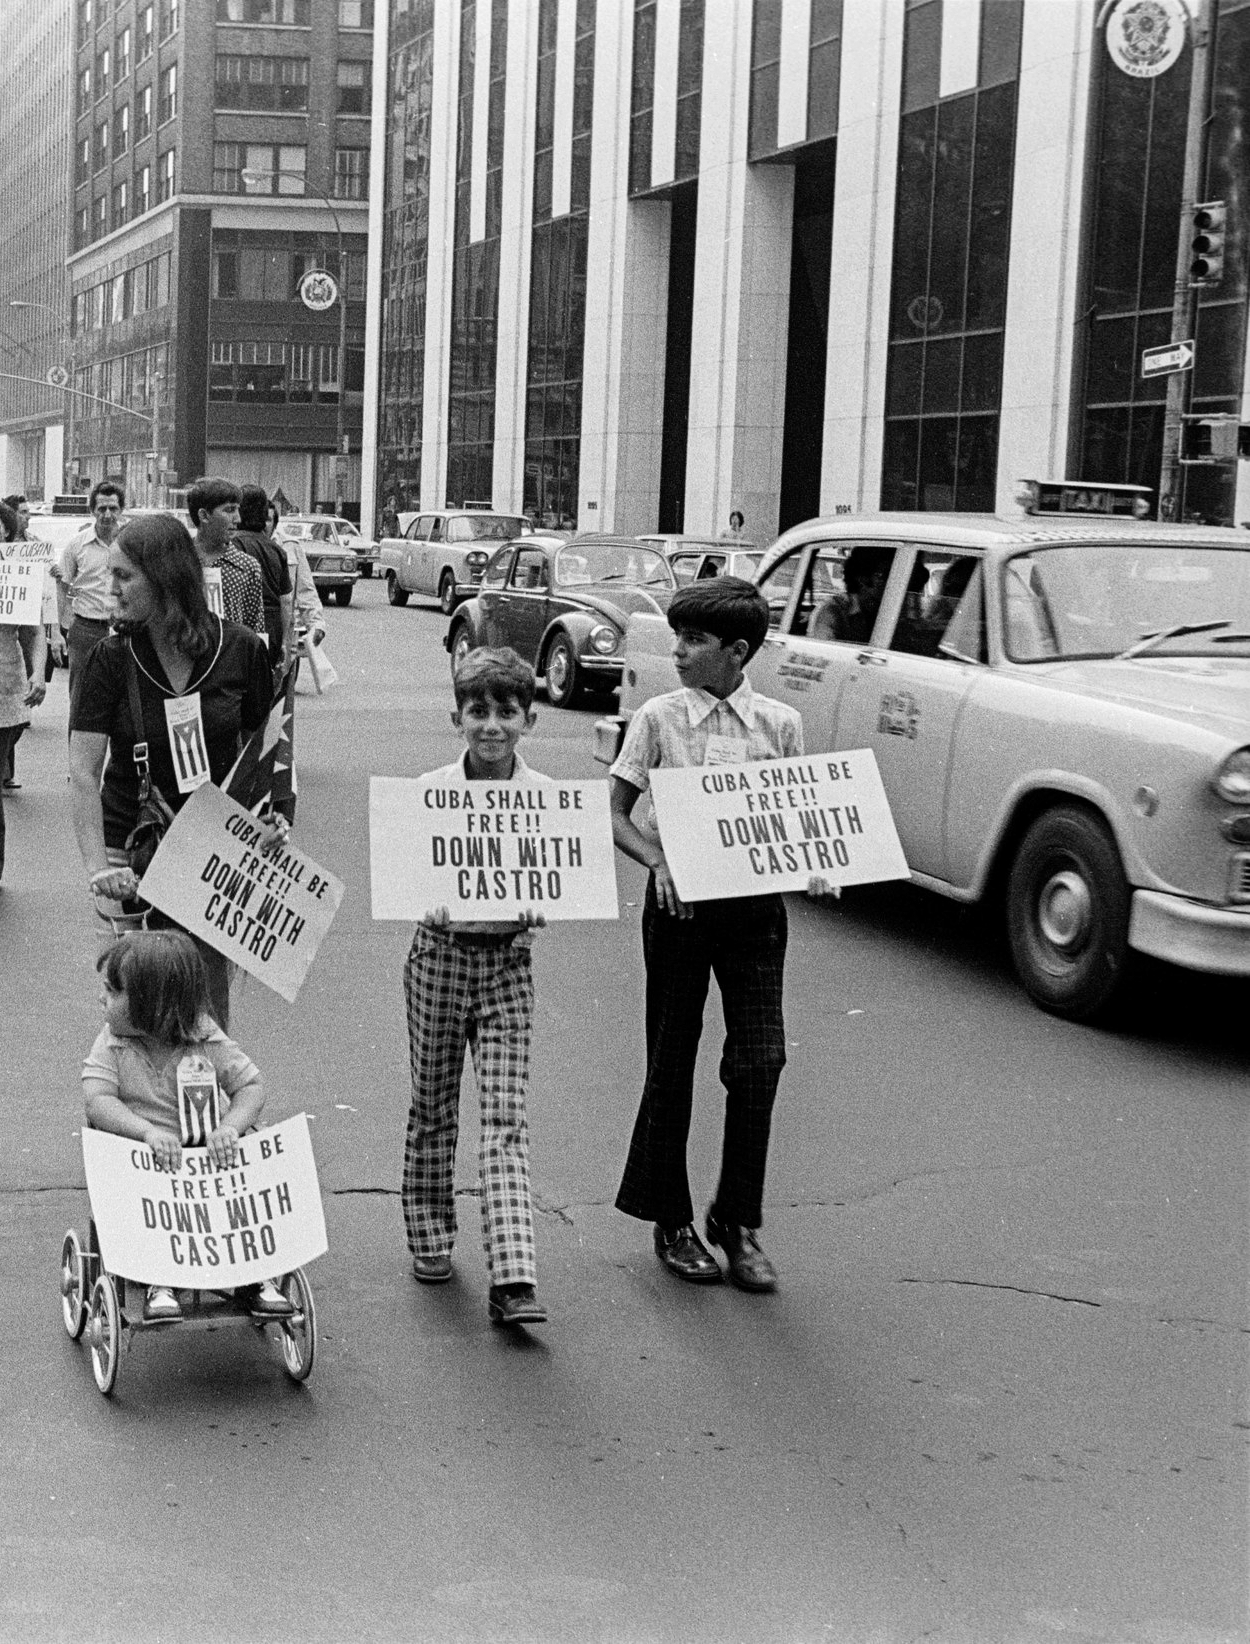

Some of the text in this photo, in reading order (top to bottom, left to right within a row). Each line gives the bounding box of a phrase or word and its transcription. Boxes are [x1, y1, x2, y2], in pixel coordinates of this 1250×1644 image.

[6, 543, 53, 557] OF CUBAN
[18, 565, 31, 575] BE
[702, 761, 853, 794] CUBA SHALL BE
[424, 789, 583, 810] CUBA SHALL BE
[745, 787, 818, 812] FREE!!
[467, 813, 541, 833] FREE!!
[717, 805, 864, 848] DOWN WITH
[225, 814, 329, 900] CUBA SHALL BE
[432, 836, 582, 868] DOWN WITH
[749, 838, 851, 875] CASTRO
[239, 851, 292, 899] FREE!!
[458, 869, 562, 901] CASTRO
[201, 853, 306, 946] DOWN WITH
[204, 893, 277, 962] CASTRO
[260, 1134, 285, 1160] BE
[171, 1172, 248, 1200] FREE!!
[141, 1181, 293, 1234] DOWN WITH
[170, 1224, 276, 1267] CASTRO
